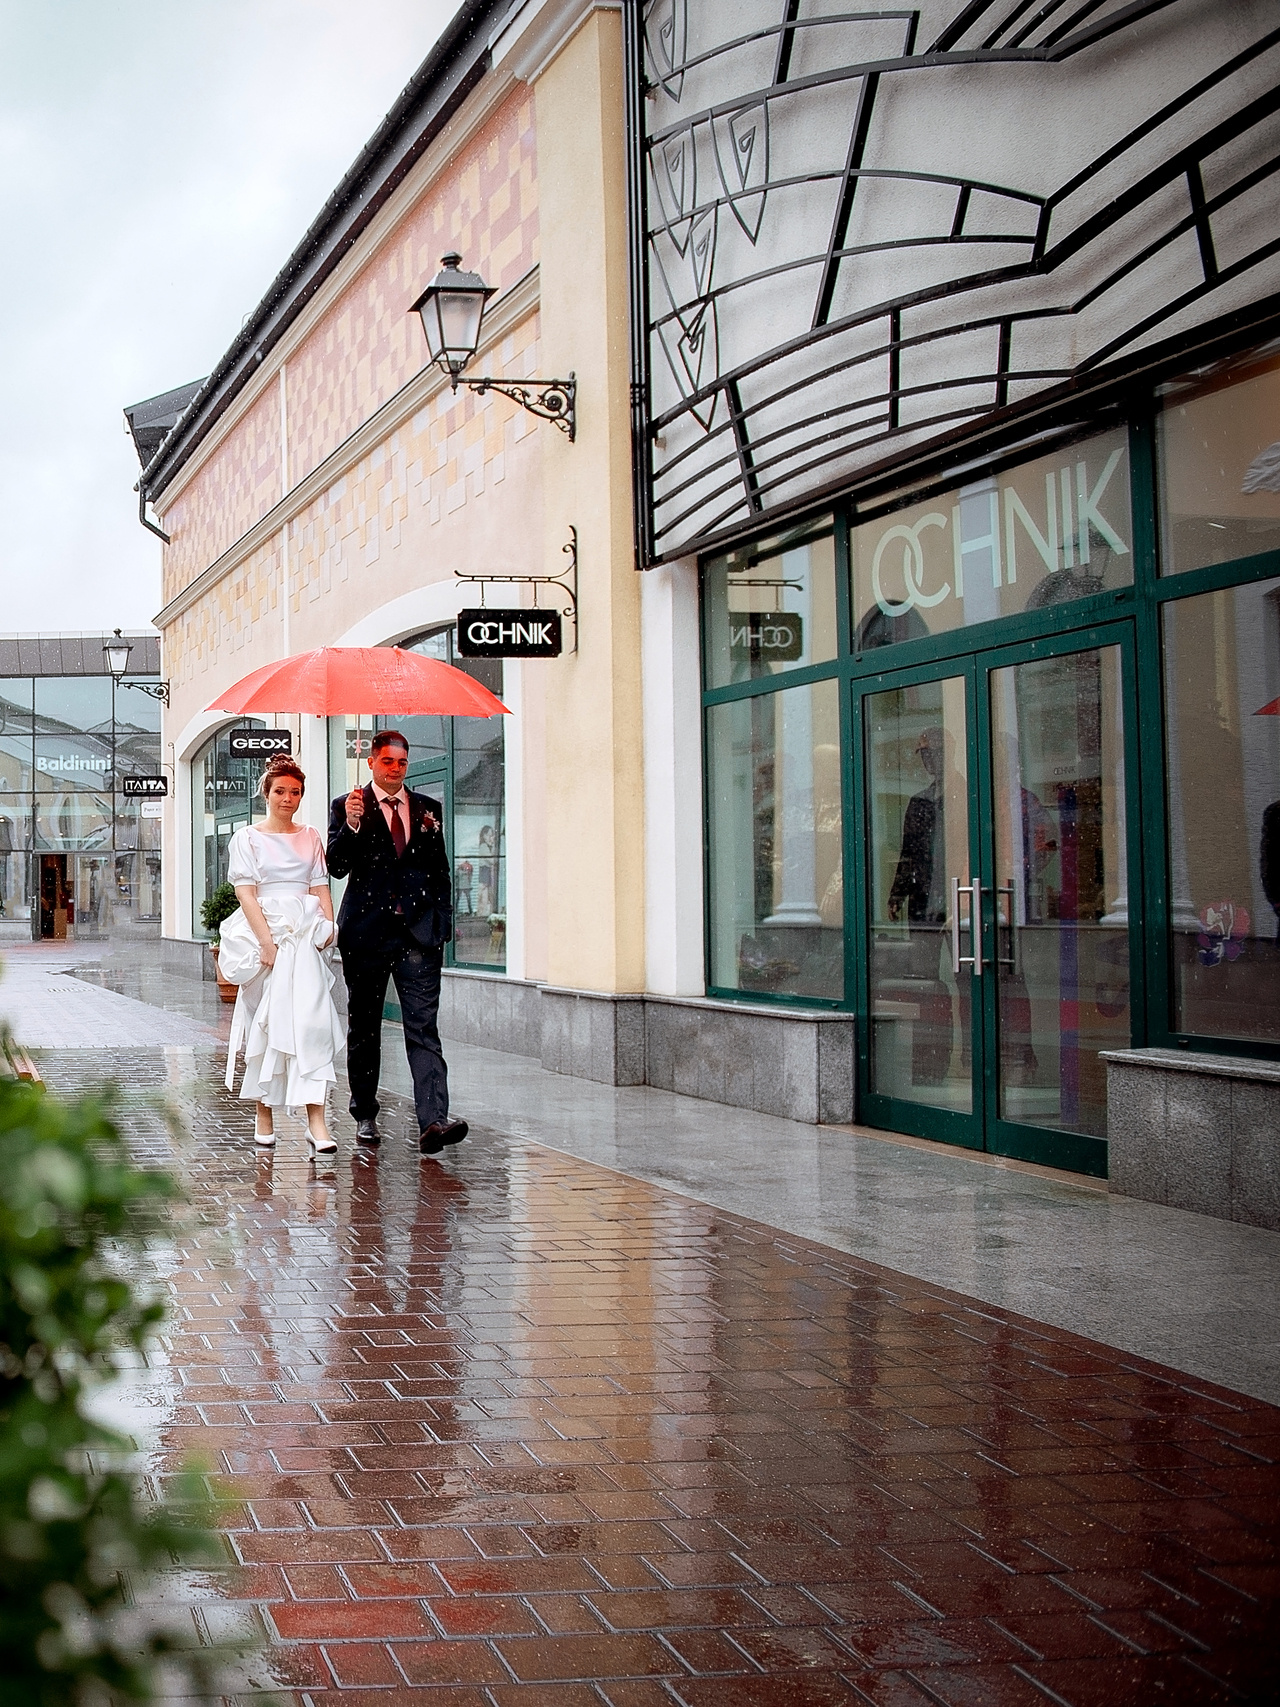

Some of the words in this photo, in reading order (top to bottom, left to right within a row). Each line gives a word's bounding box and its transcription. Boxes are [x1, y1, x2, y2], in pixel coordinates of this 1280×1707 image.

[872, 447, 1130, 617] OCHNIK
[467, 621, 553, 645] OCHNIK
[232, 738, 290, 749] GEOX
[36, 754, 112, 771] Baldinini
